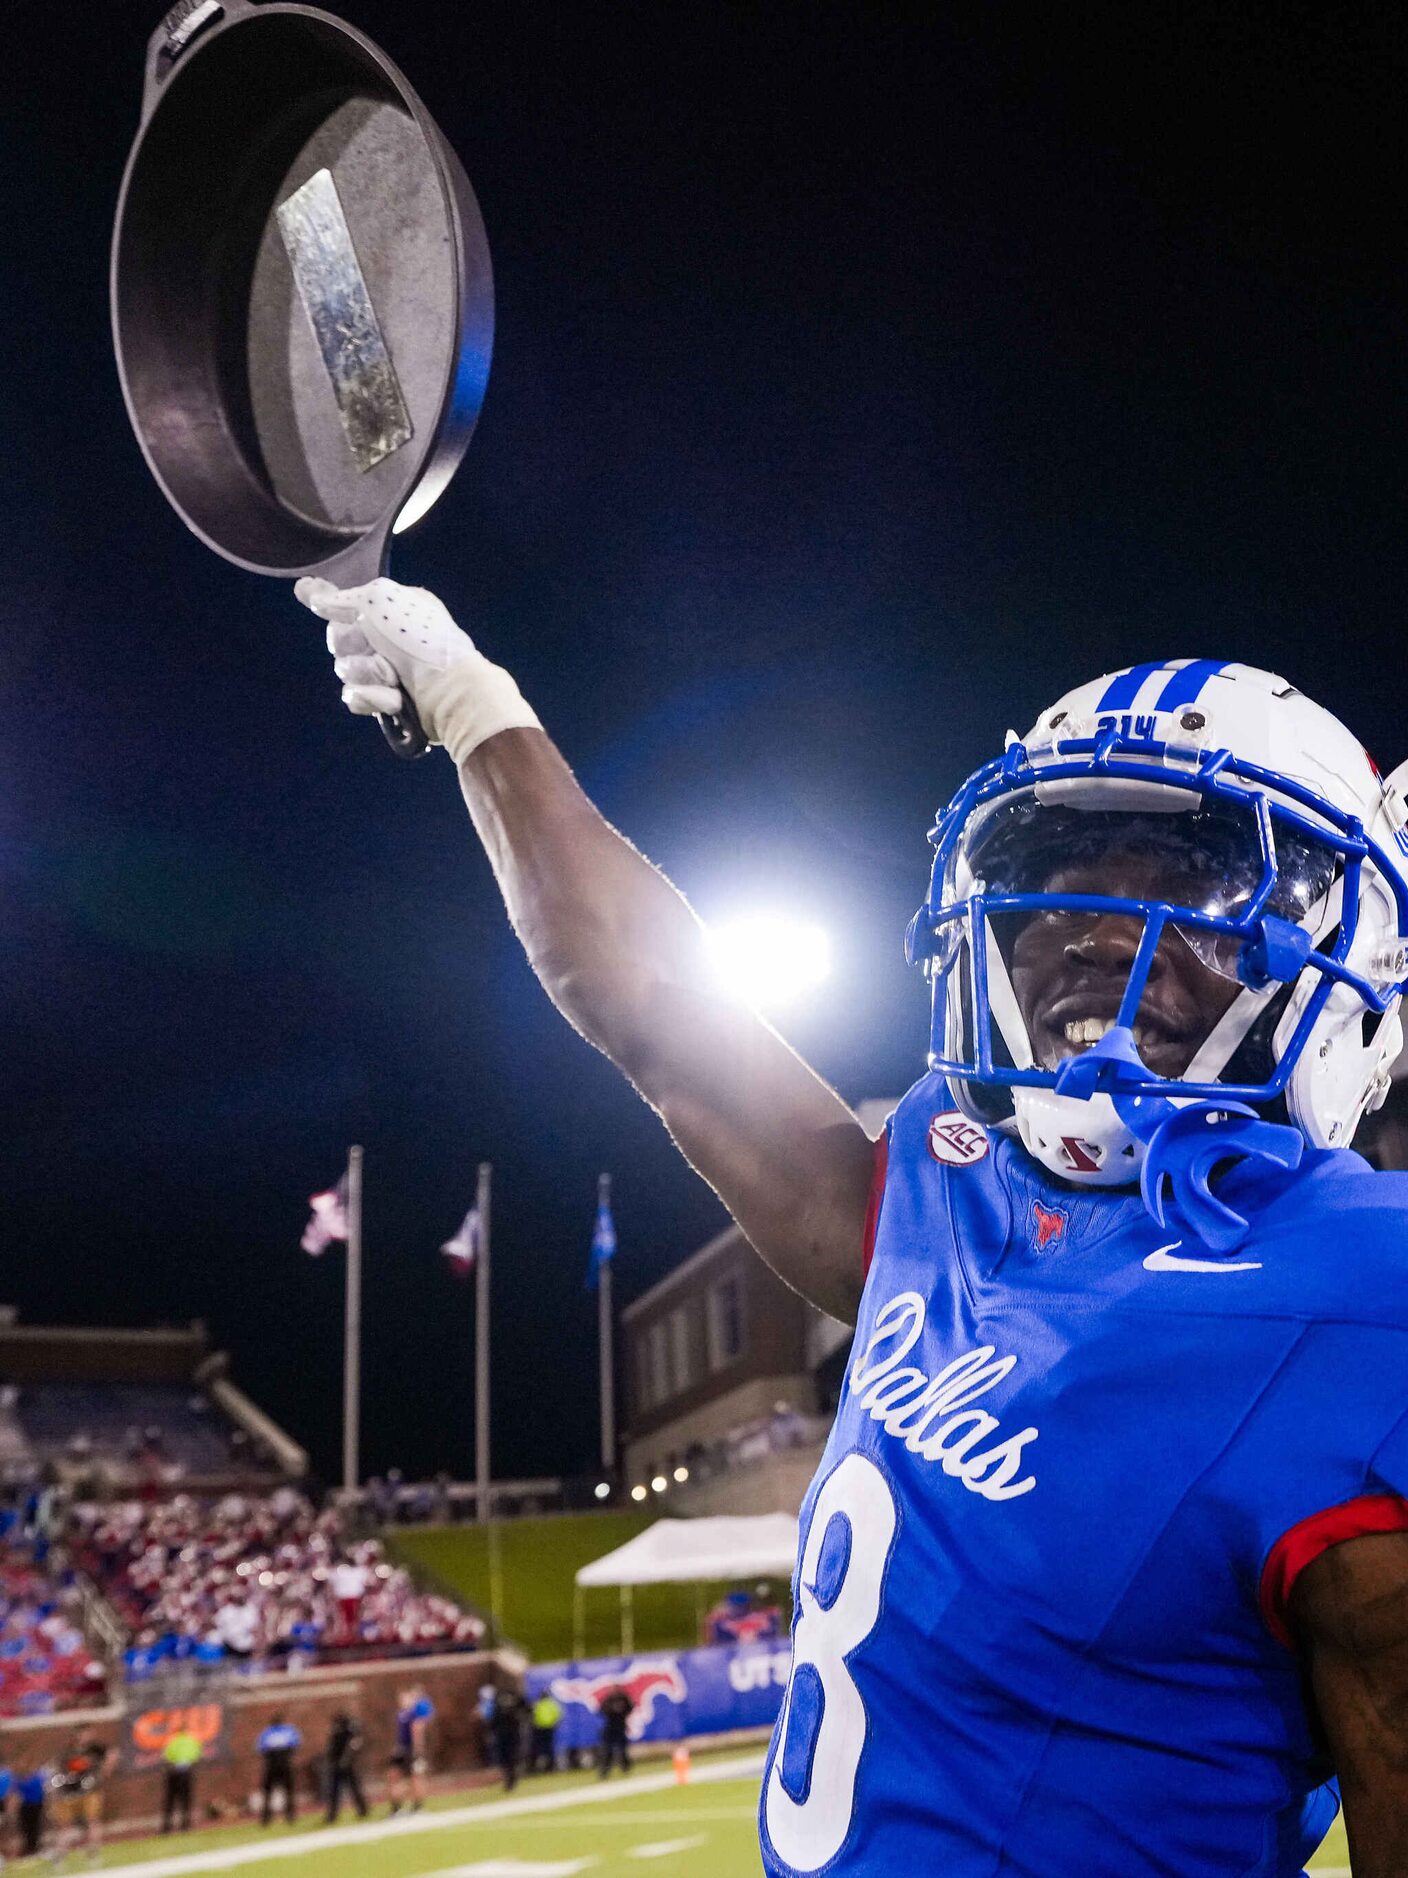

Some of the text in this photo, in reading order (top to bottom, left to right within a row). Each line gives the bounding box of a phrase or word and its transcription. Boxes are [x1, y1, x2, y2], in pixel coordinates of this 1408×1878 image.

[938, 1122, 986, 1154] ACC
[850, 1291, 1039, 1501] Dallas
[766, 1453, 897, 1873] 8
